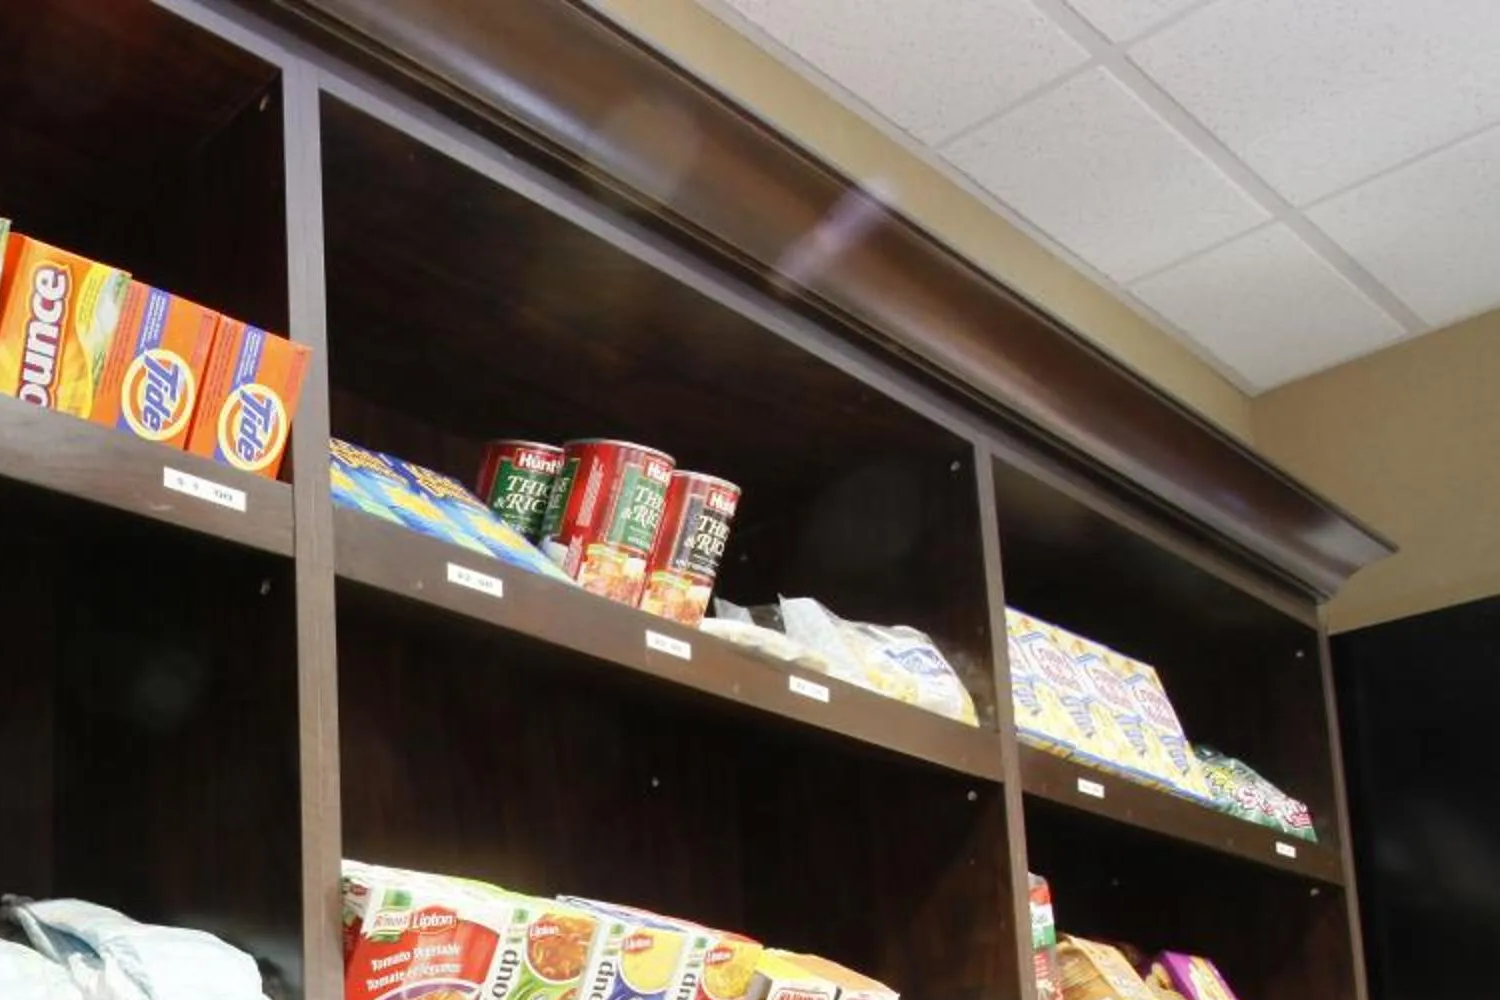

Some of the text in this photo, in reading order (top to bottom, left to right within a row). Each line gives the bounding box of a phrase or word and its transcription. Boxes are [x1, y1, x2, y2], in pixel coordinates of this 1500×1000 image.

[19, 265, 70, 408] ounce
[143, 350, 184, 433] Tide
[237, 389, 277, 463] Tide
[505, 493, 548, 514] RIC
